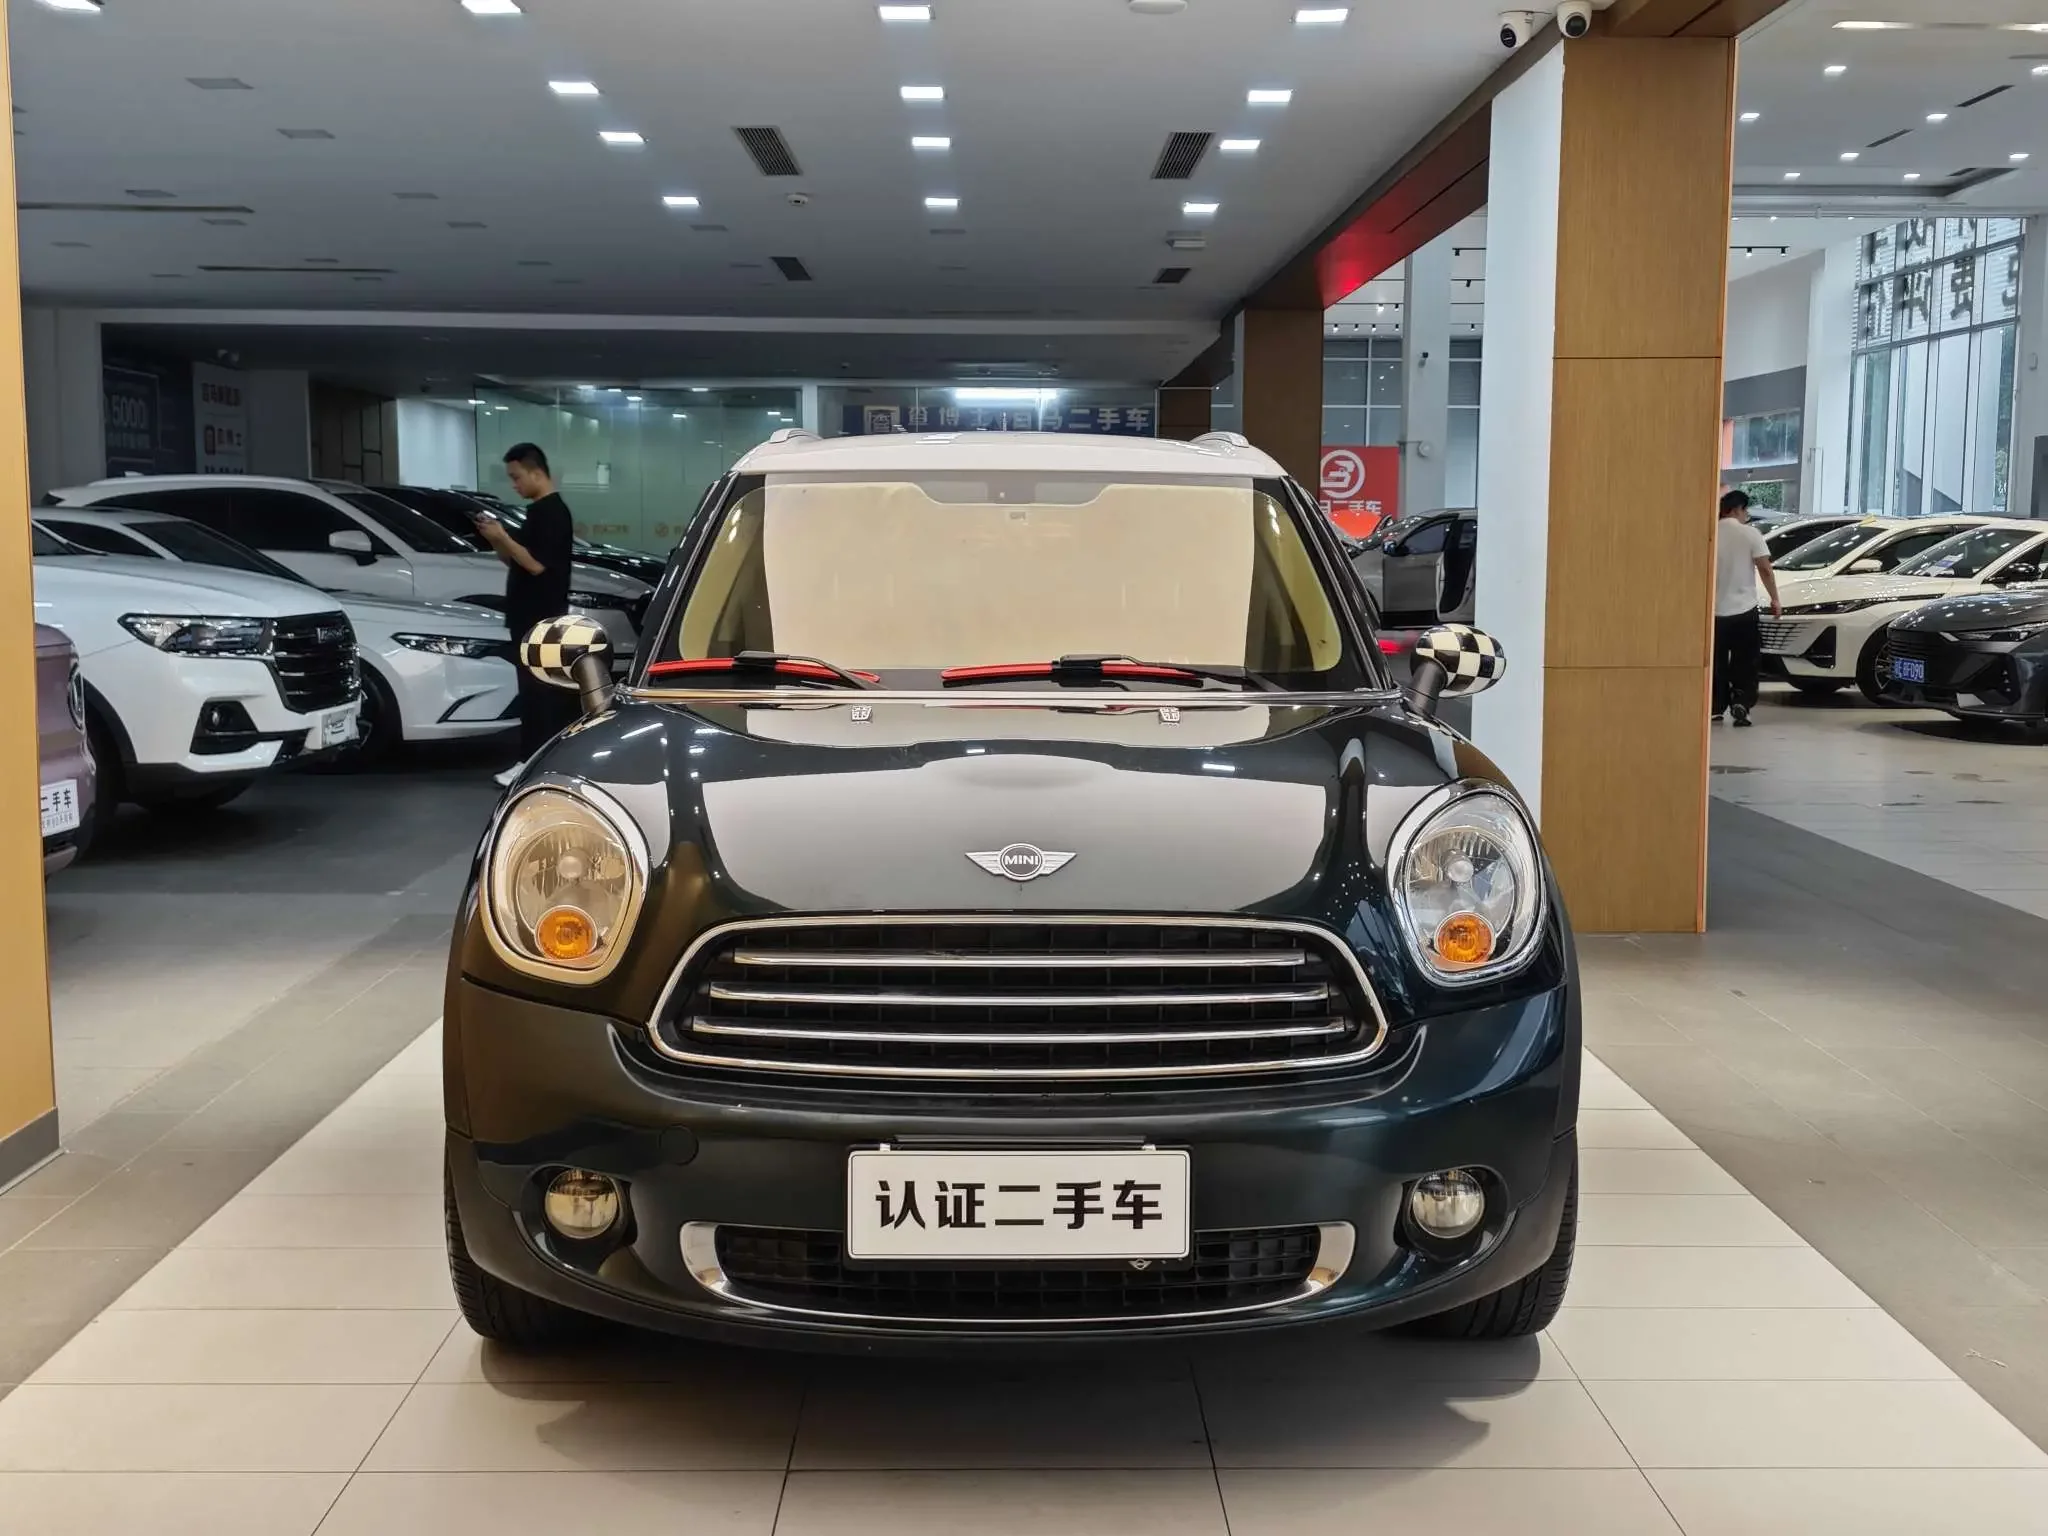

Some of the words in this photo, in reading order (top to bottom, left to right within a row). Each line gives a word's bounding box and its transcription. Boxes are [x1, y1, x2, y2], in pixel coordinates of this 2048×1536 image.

[1004, 855, 1039, 865] MINI
[875, 1179, 1163, 1230] 认证二手车
